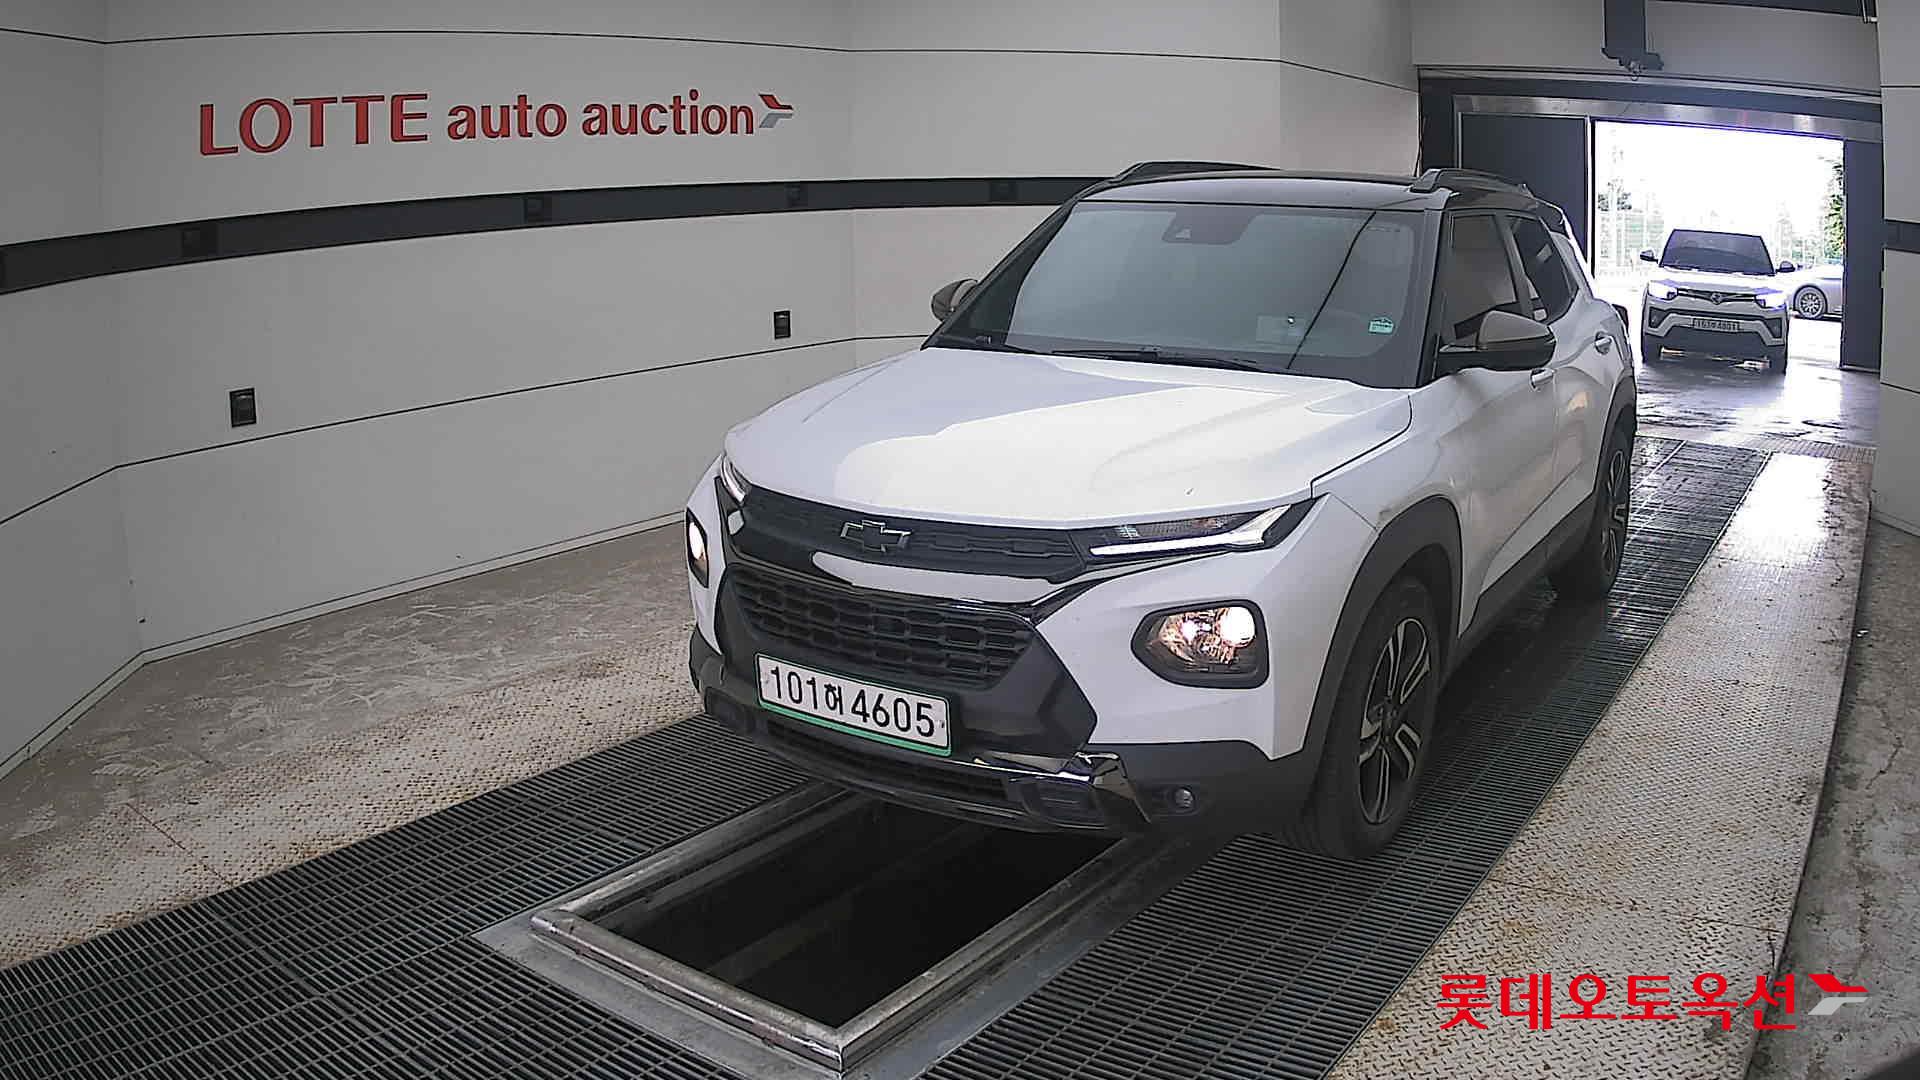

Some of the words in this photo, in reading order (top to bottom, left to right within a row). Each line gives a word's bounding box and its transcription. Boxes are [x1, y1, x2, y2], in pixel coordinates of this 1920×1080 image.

[199, 94, 428, 156] LOTTE
[447, 95, 567, 140] auto
[581, 89, 754, 136] auction
